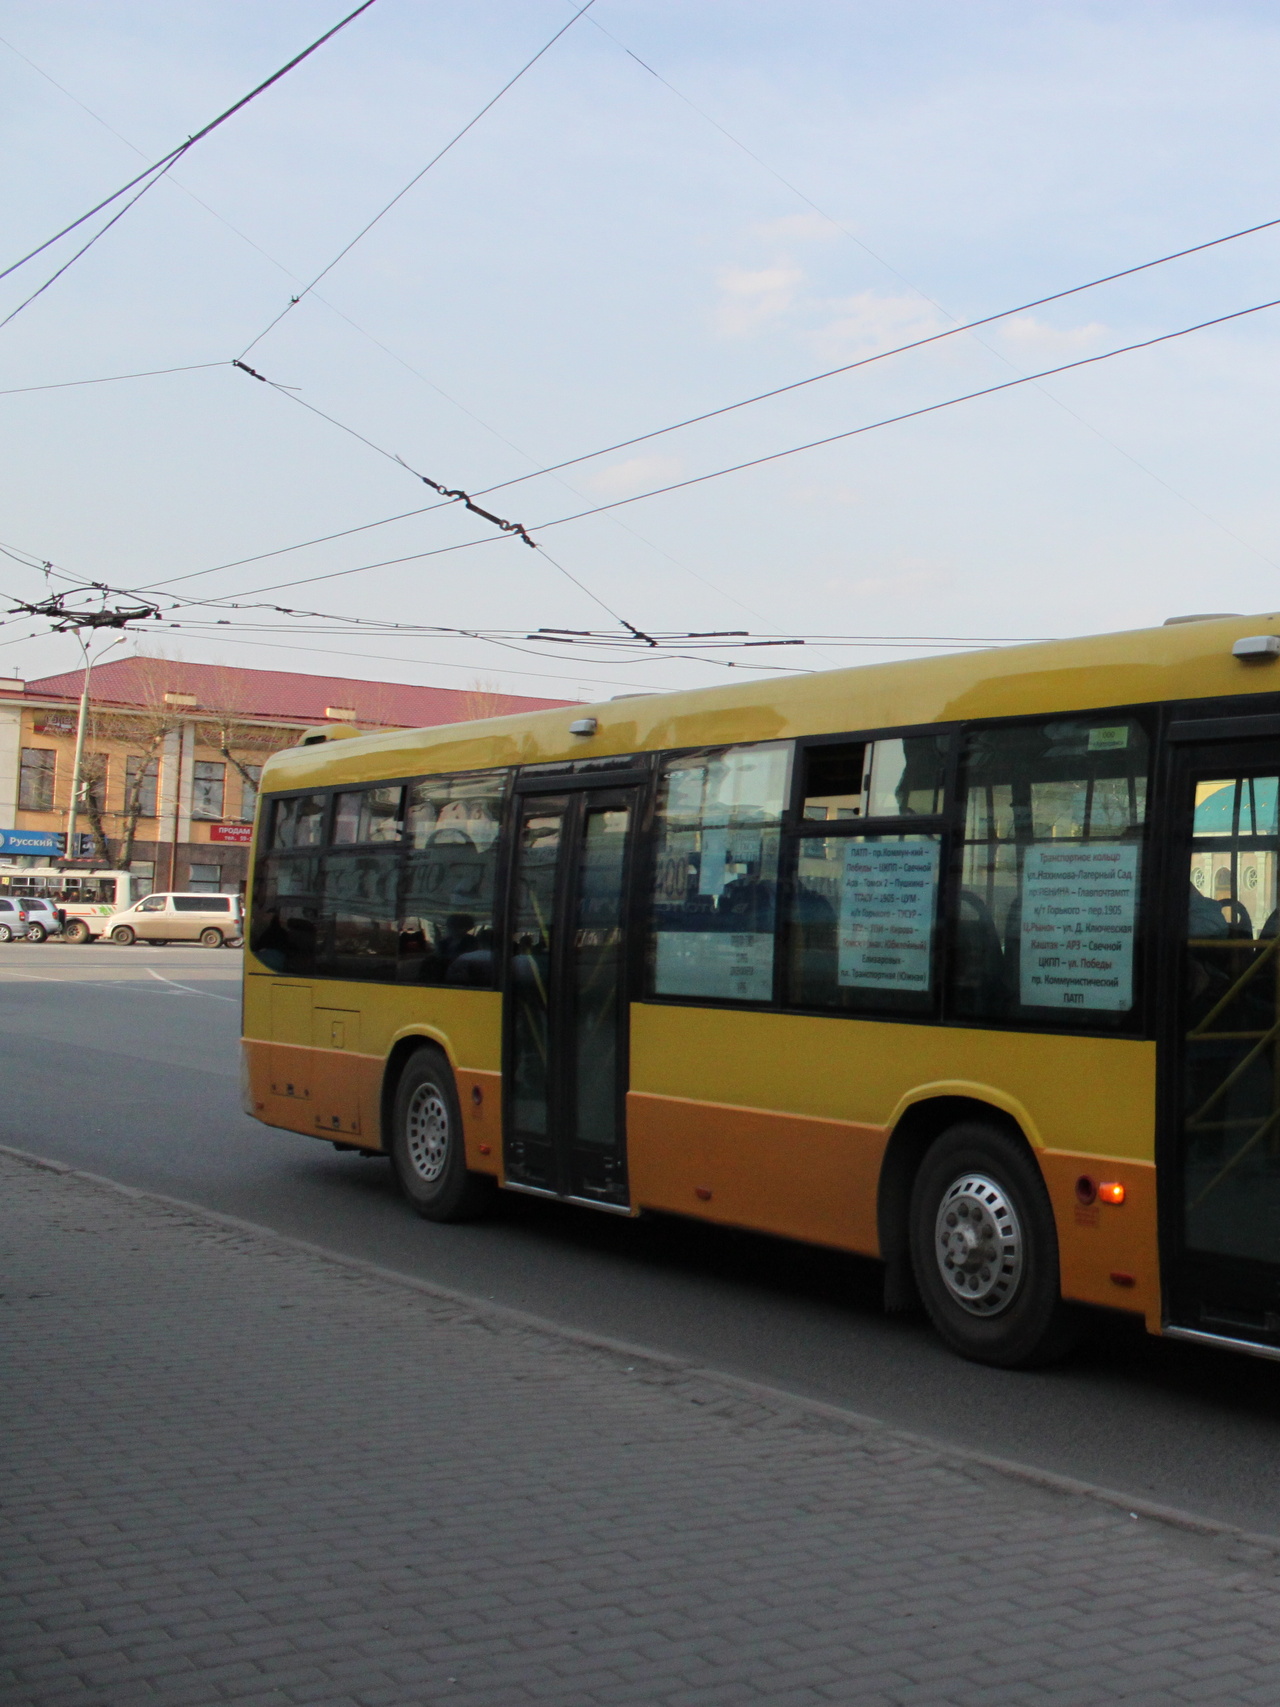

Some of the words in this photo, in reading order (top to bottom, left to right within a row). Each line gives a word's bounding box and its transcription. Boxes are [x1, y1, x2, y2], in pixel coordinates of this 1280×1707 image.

[218, 827, 251, 835] ПРОДАМ
[9, 837, 53, 847] Русский
[1040, 853, 1092, 864] Транспортное
[1092, 853, 1121, 863] кольцо
[903, 862, 932, 872] Свечной
[1117, 869, 1132, 881] Сад
[1047, 905, 1080, 917] Горького
[1085, 923, 1132, 934] Ключевская
[1088, 940, 1122, 952] Свечной
[1038, 957, 1060, 969] ЦКПП
[1080, 958, 1113, 971] Победы
[1044, 974, 1119, 988] Коммунистический
[1063, 993, 1084, 1004] ПАТП
